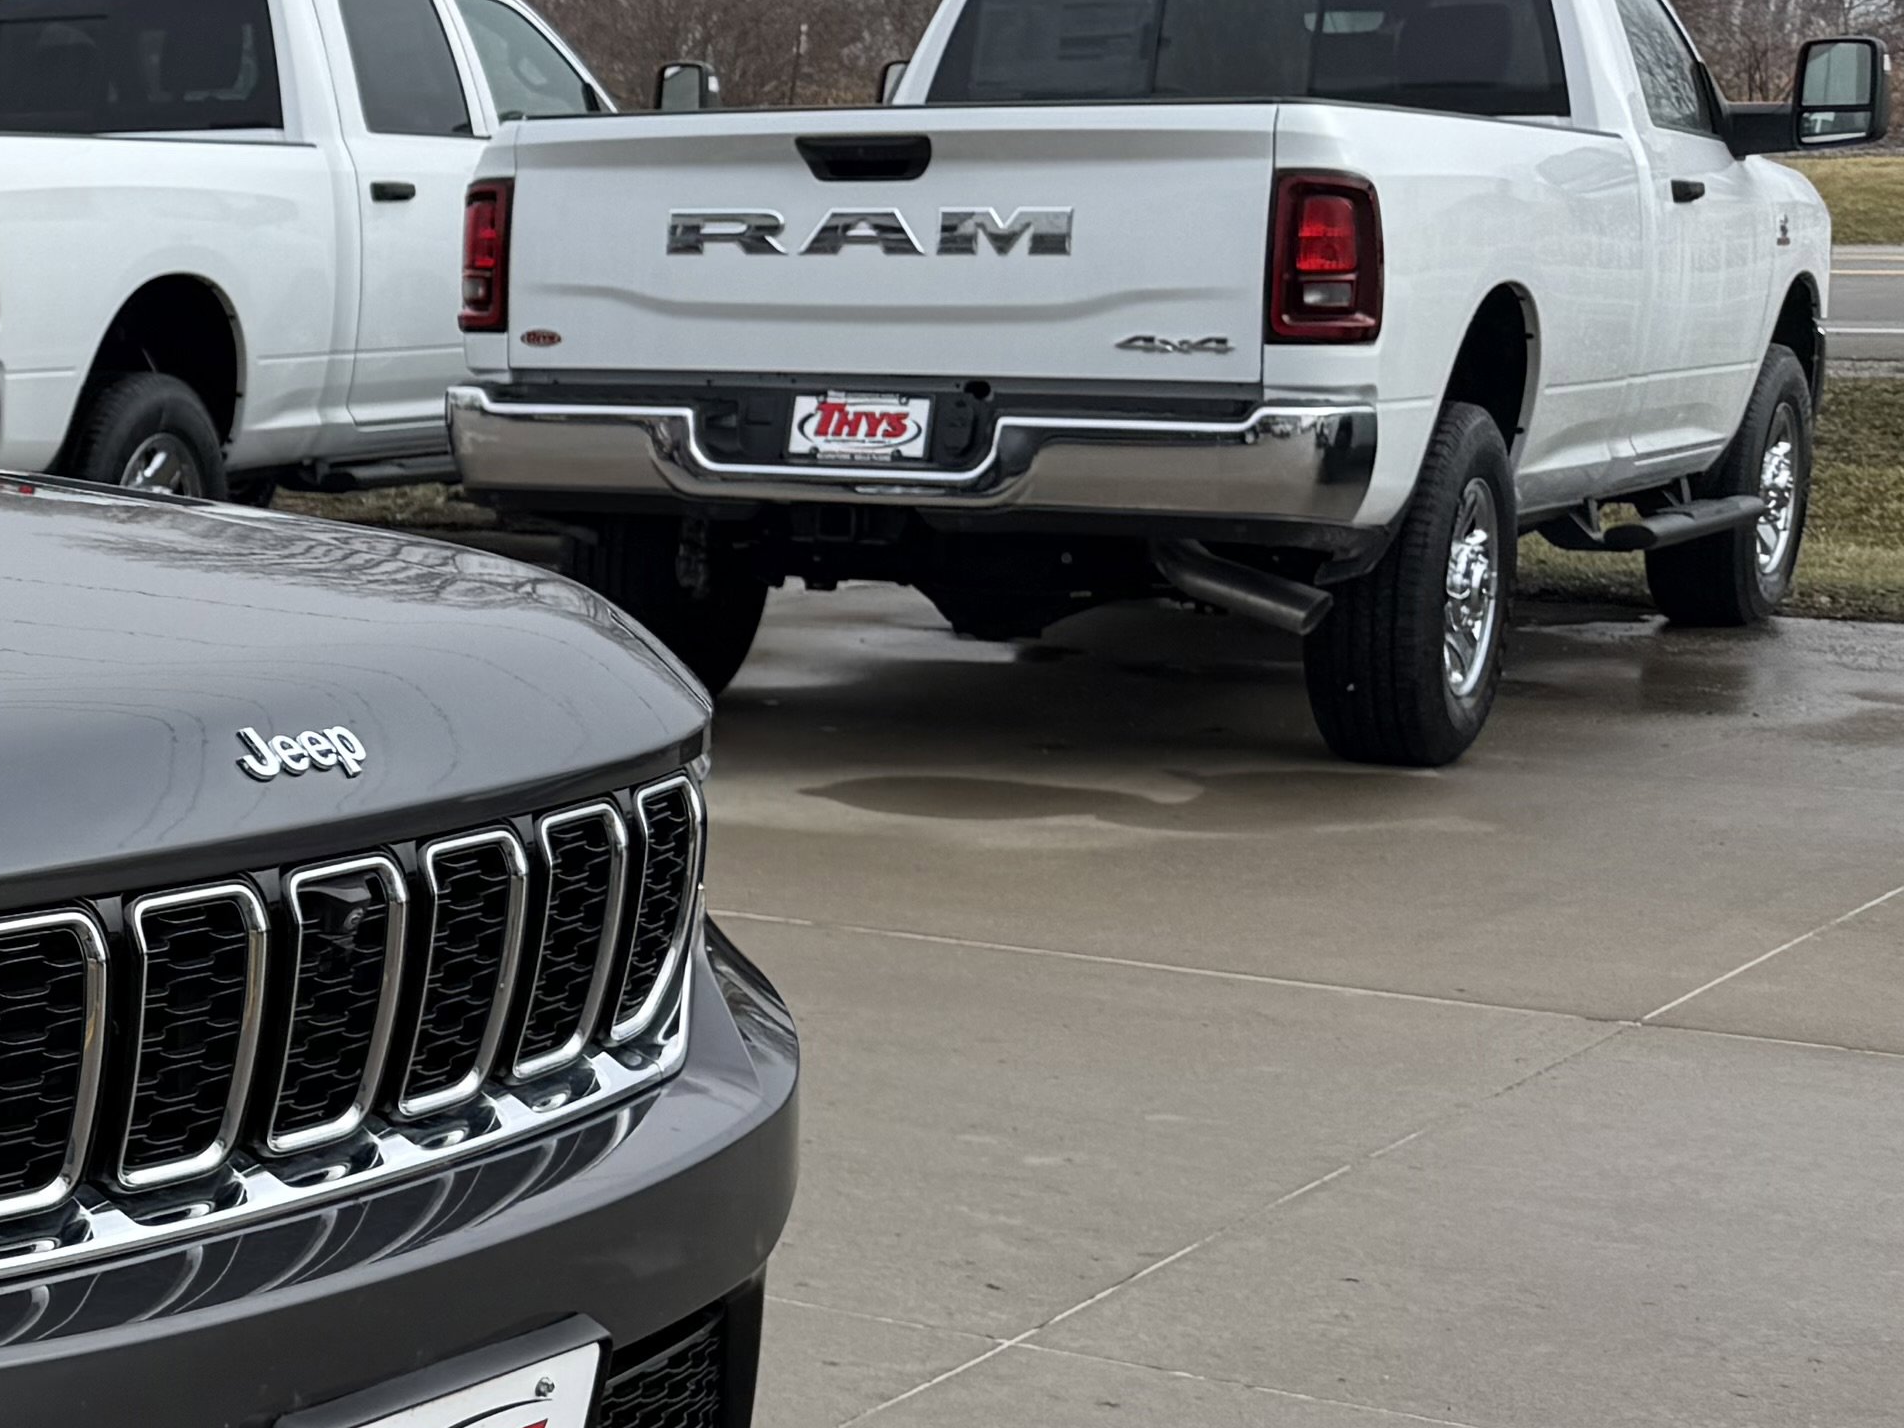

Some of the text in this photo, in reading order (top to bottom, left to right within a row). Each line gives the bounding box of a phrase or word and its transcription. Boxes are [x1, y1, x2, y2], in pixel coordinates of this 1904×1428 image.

[665, 205, 1074, 256] RAM
[1113, 334, 1236, 354] 4x4
[814, 402, 910, 439] THYS
[236, 726, 367, 780] Jeep
